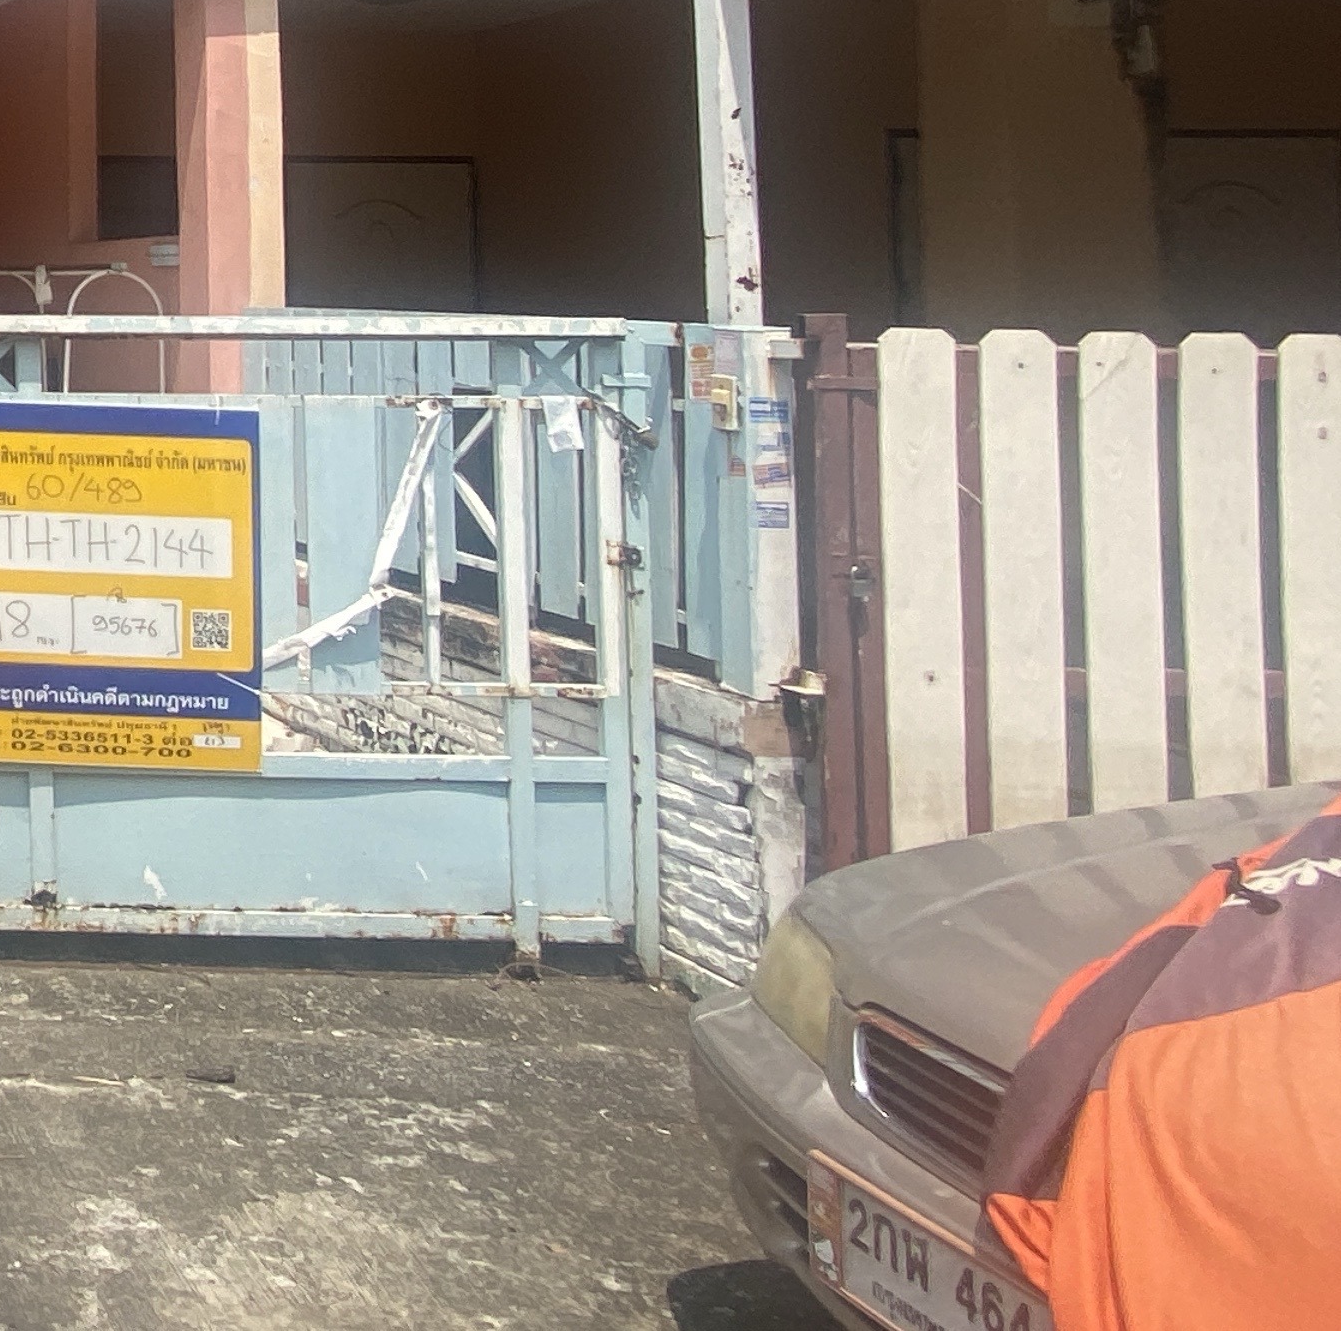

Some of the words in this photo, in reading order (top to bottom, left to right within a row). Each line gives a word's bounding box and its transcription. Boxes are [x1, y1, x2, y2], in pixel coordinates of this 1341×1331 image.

[156, 449, 189, 469] จำกัด
[192, 455, 246, 475] (มหาชน)
[26, 472, 143, 505] 60/489
[11, 740, 192, 758] 02-6300-700
